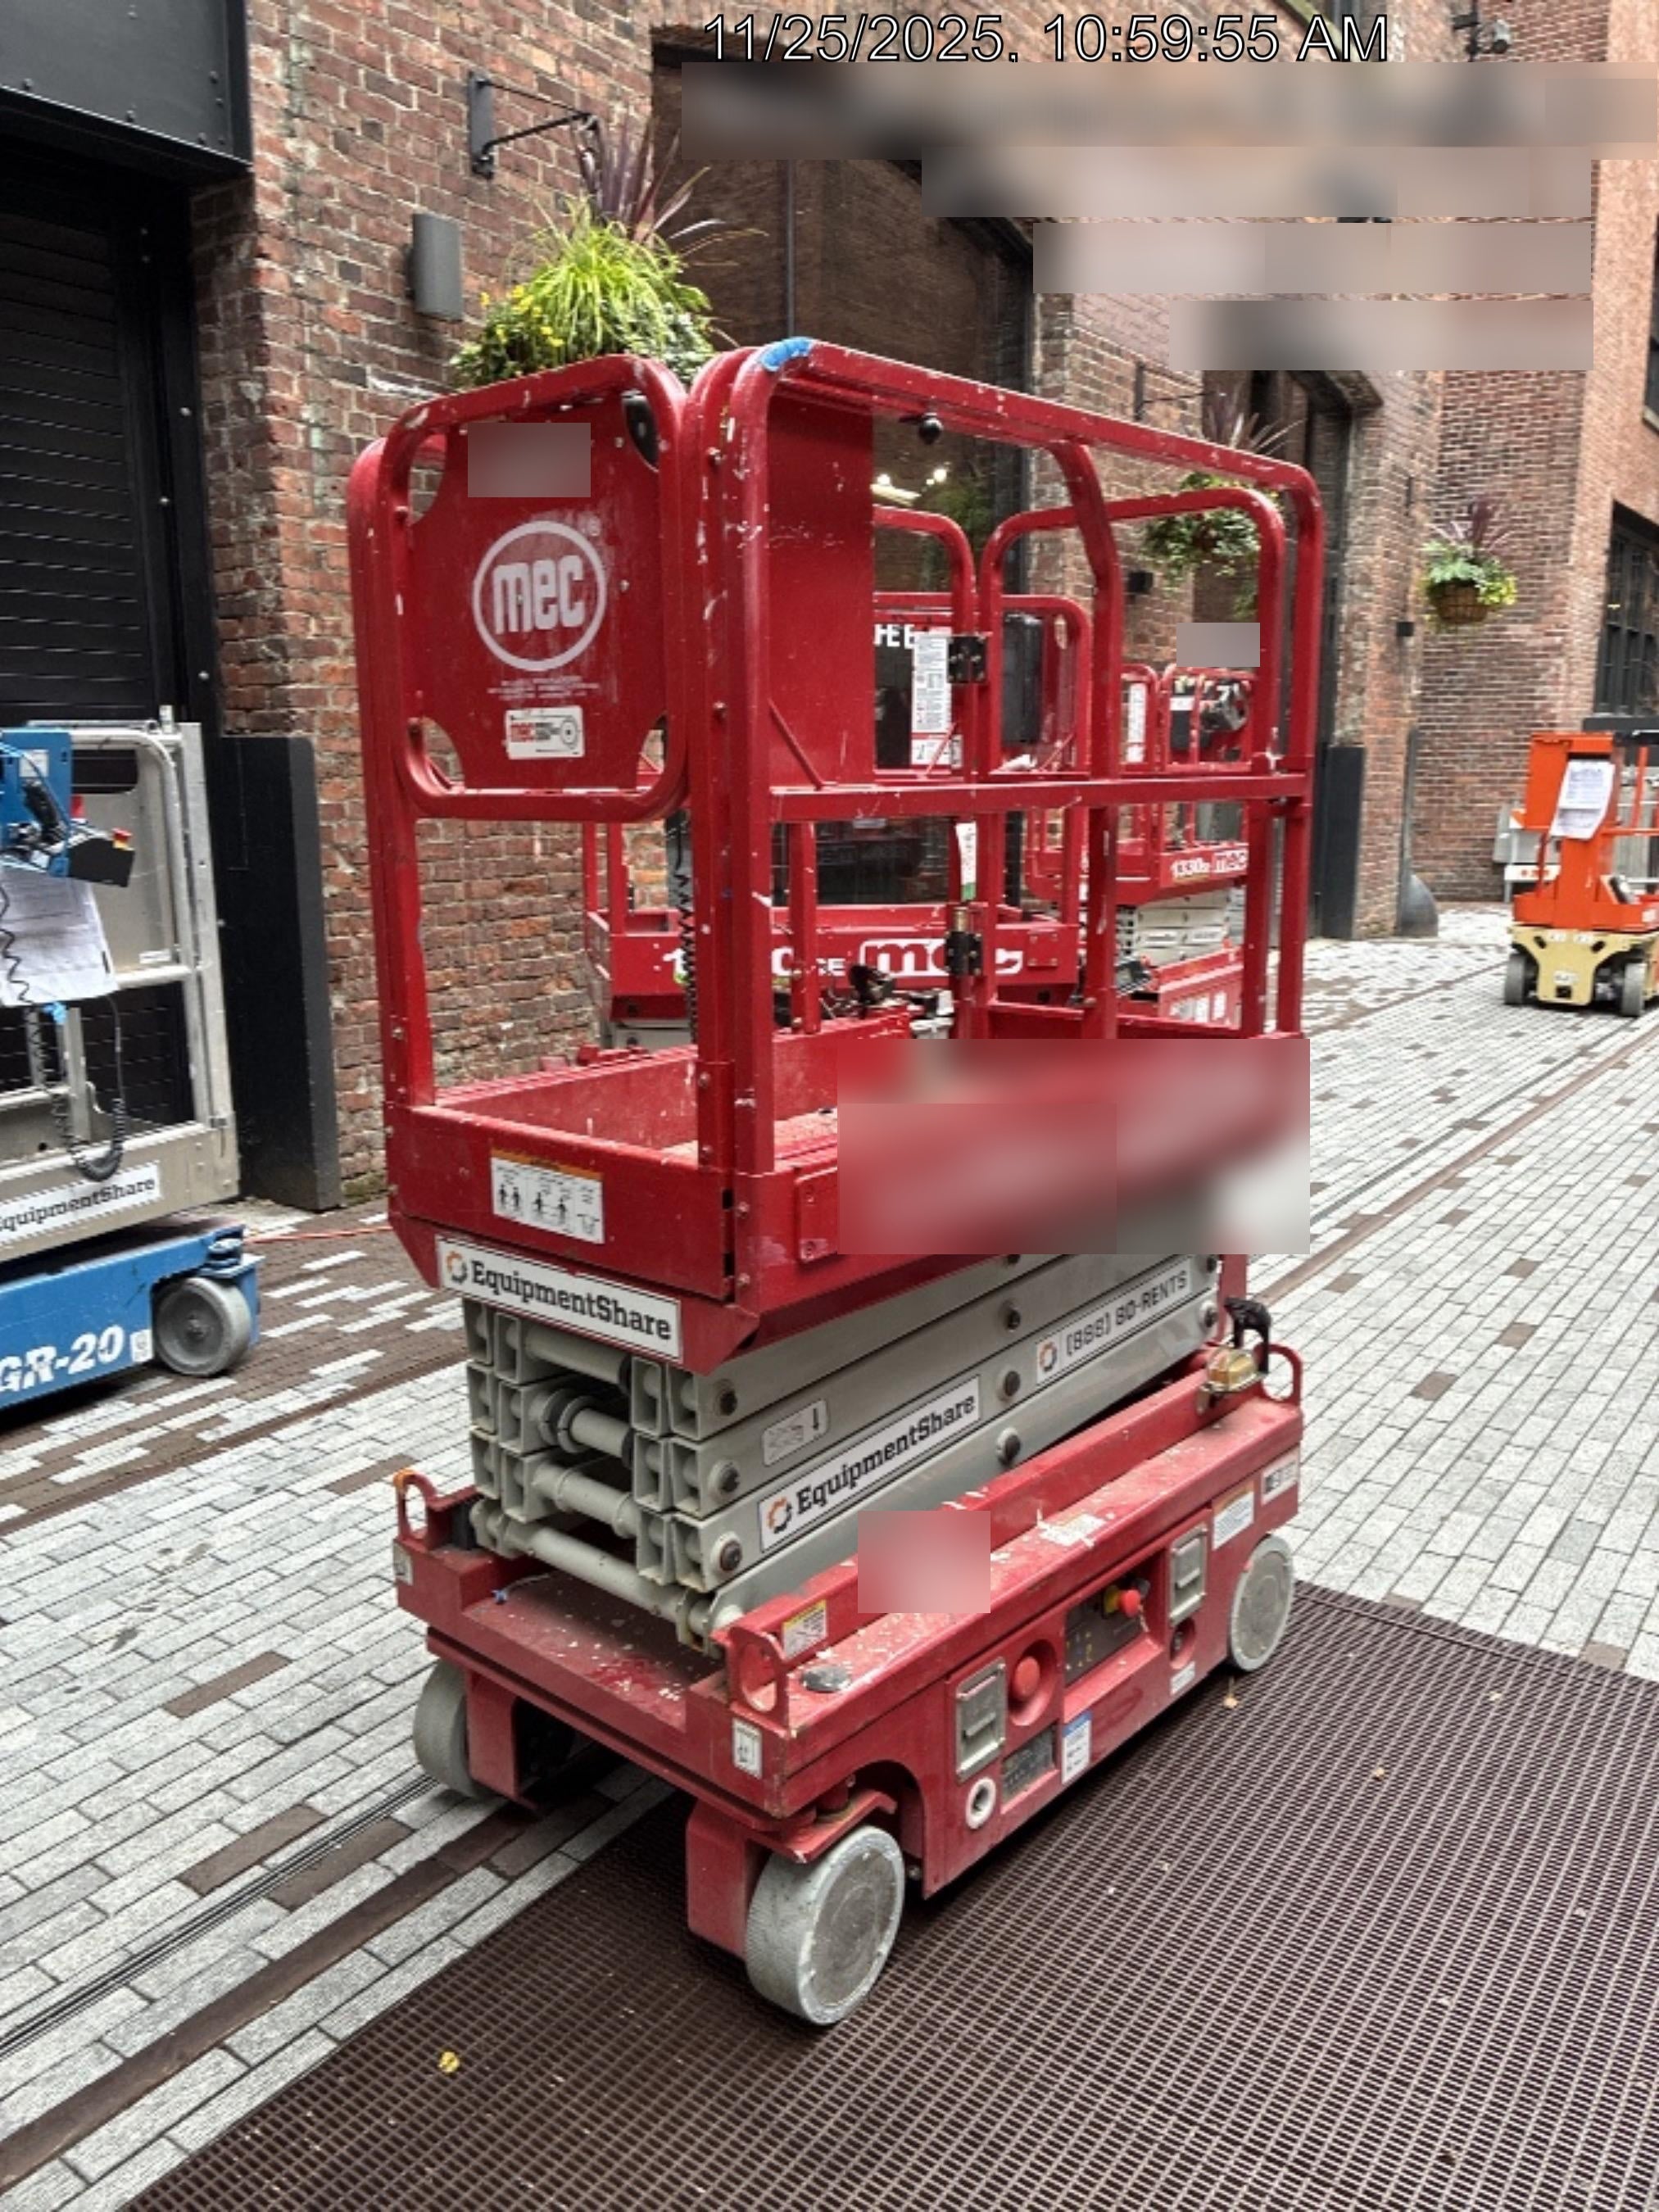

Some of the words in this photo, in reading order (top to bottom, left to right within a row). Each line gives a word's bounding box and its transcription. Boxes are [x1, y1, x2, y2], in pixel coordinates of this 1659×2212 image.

[492, 555, 585, 635] mec
[0, 1179, 156, 1232] quipmentShare
[471, 1261, 671, 1340] EquipmentShare
[796, 1394, 976, 1516] EquipmentShare
